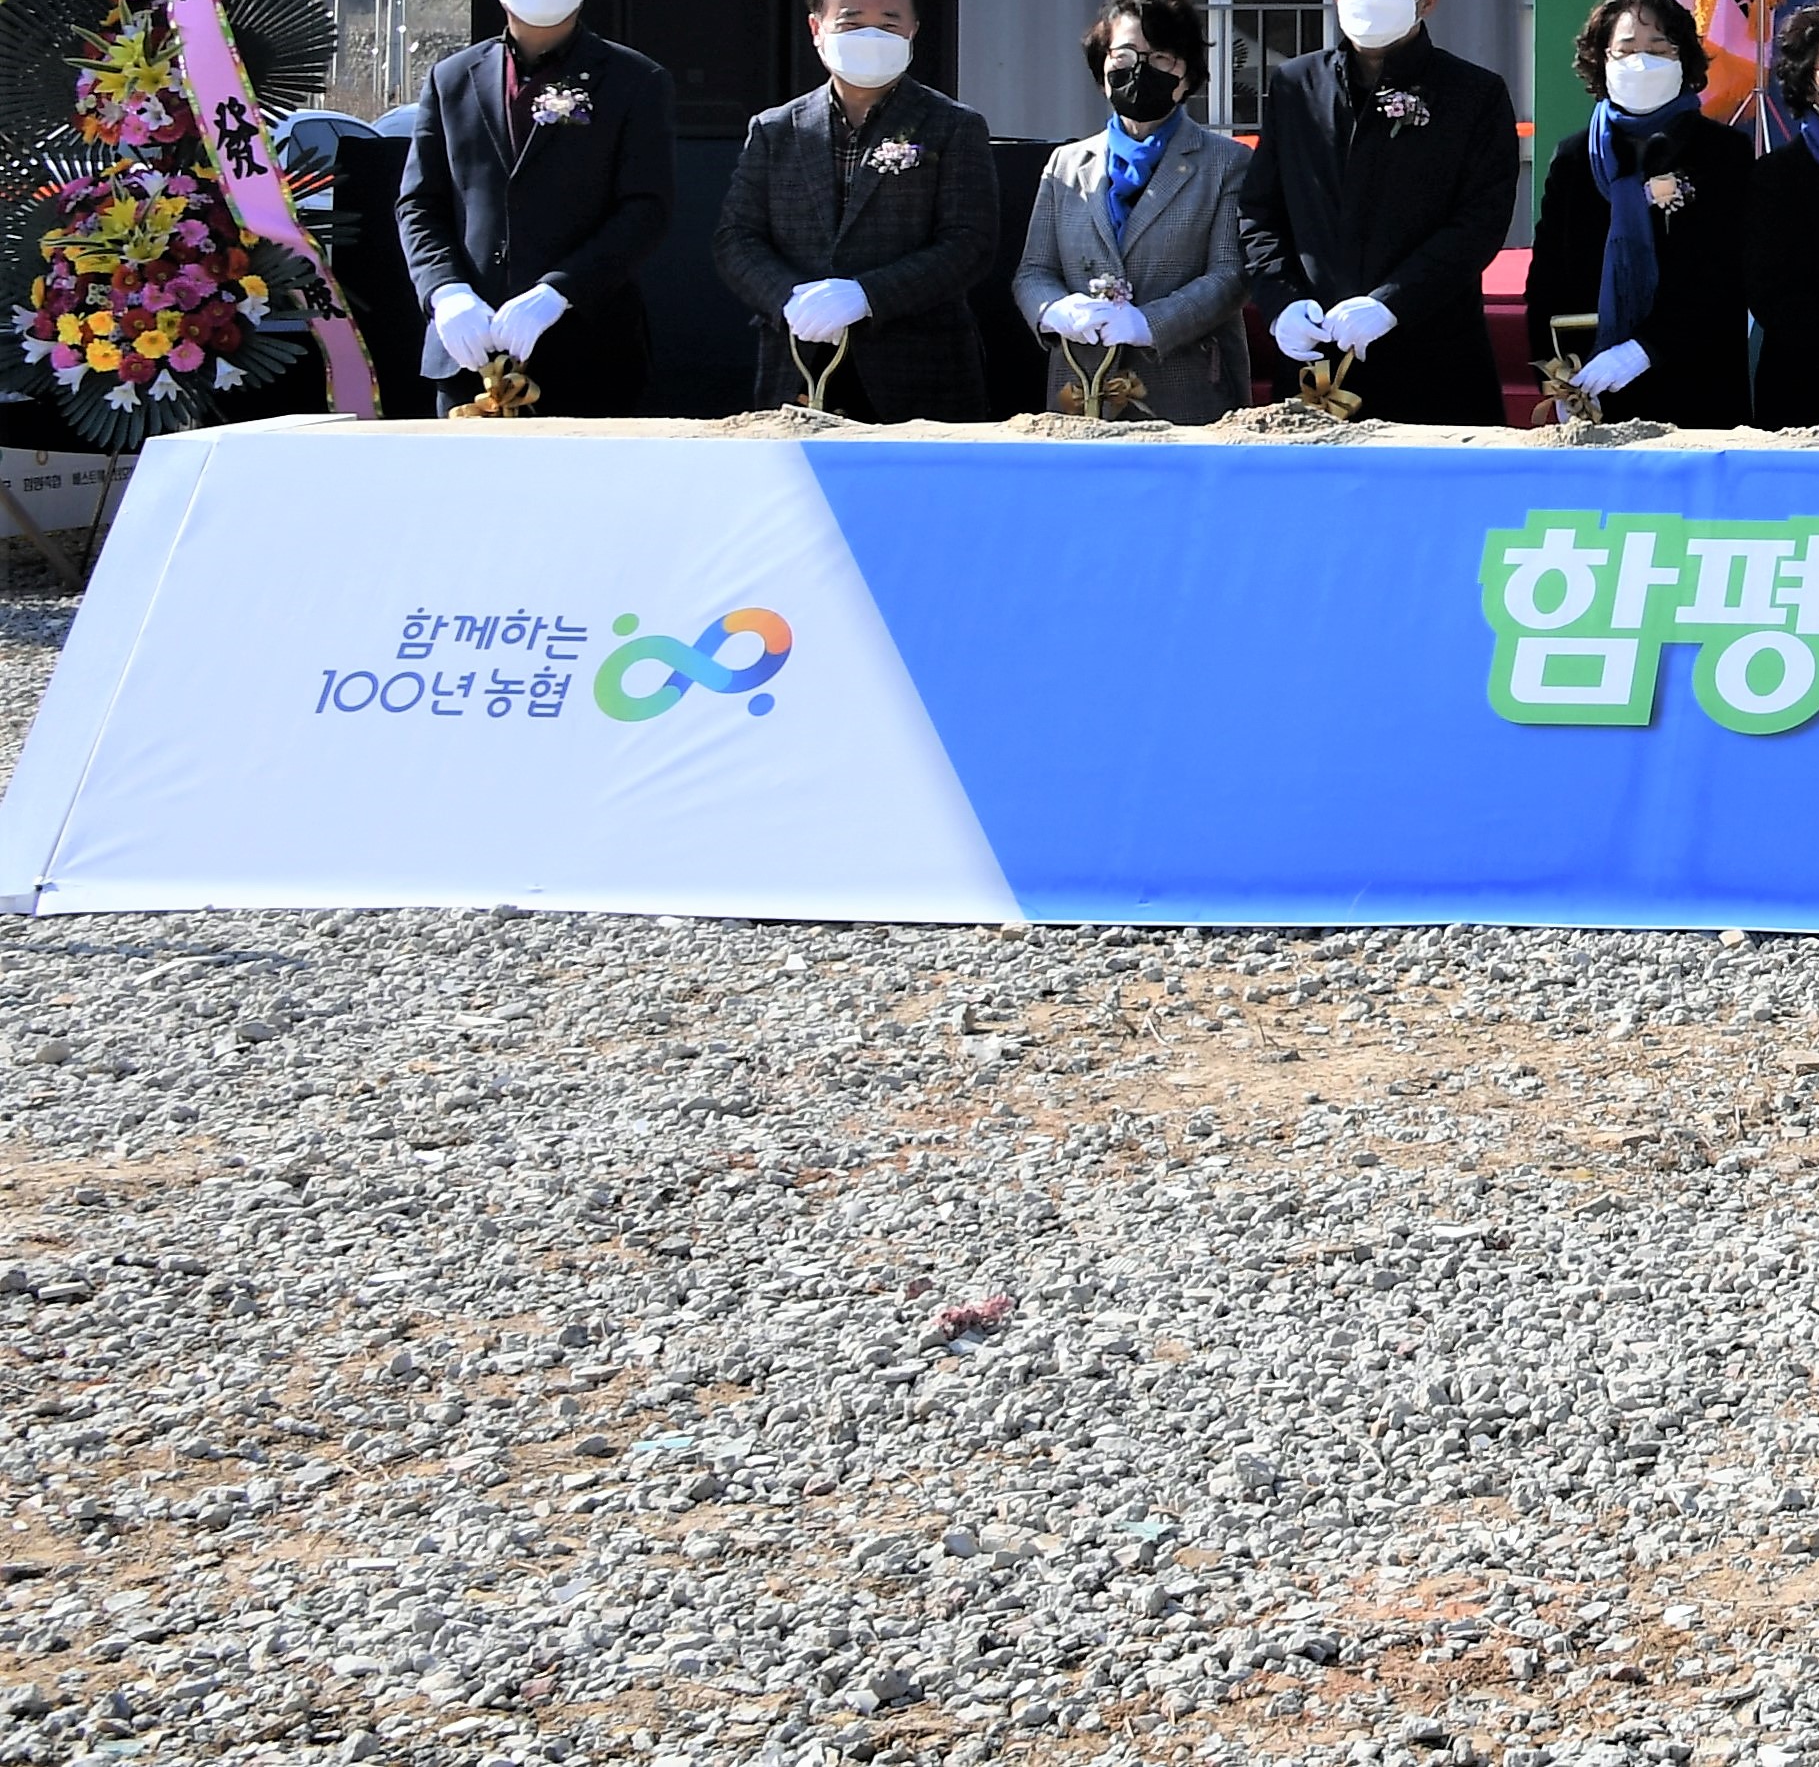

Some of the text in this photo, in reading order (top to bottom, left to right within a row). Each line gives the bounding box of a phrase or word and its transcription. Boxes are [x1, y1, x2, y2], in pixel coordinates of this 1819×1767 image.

[396, 607, 588, 660] 함께하는
[315, 665, 572, 718] 100년 농협
